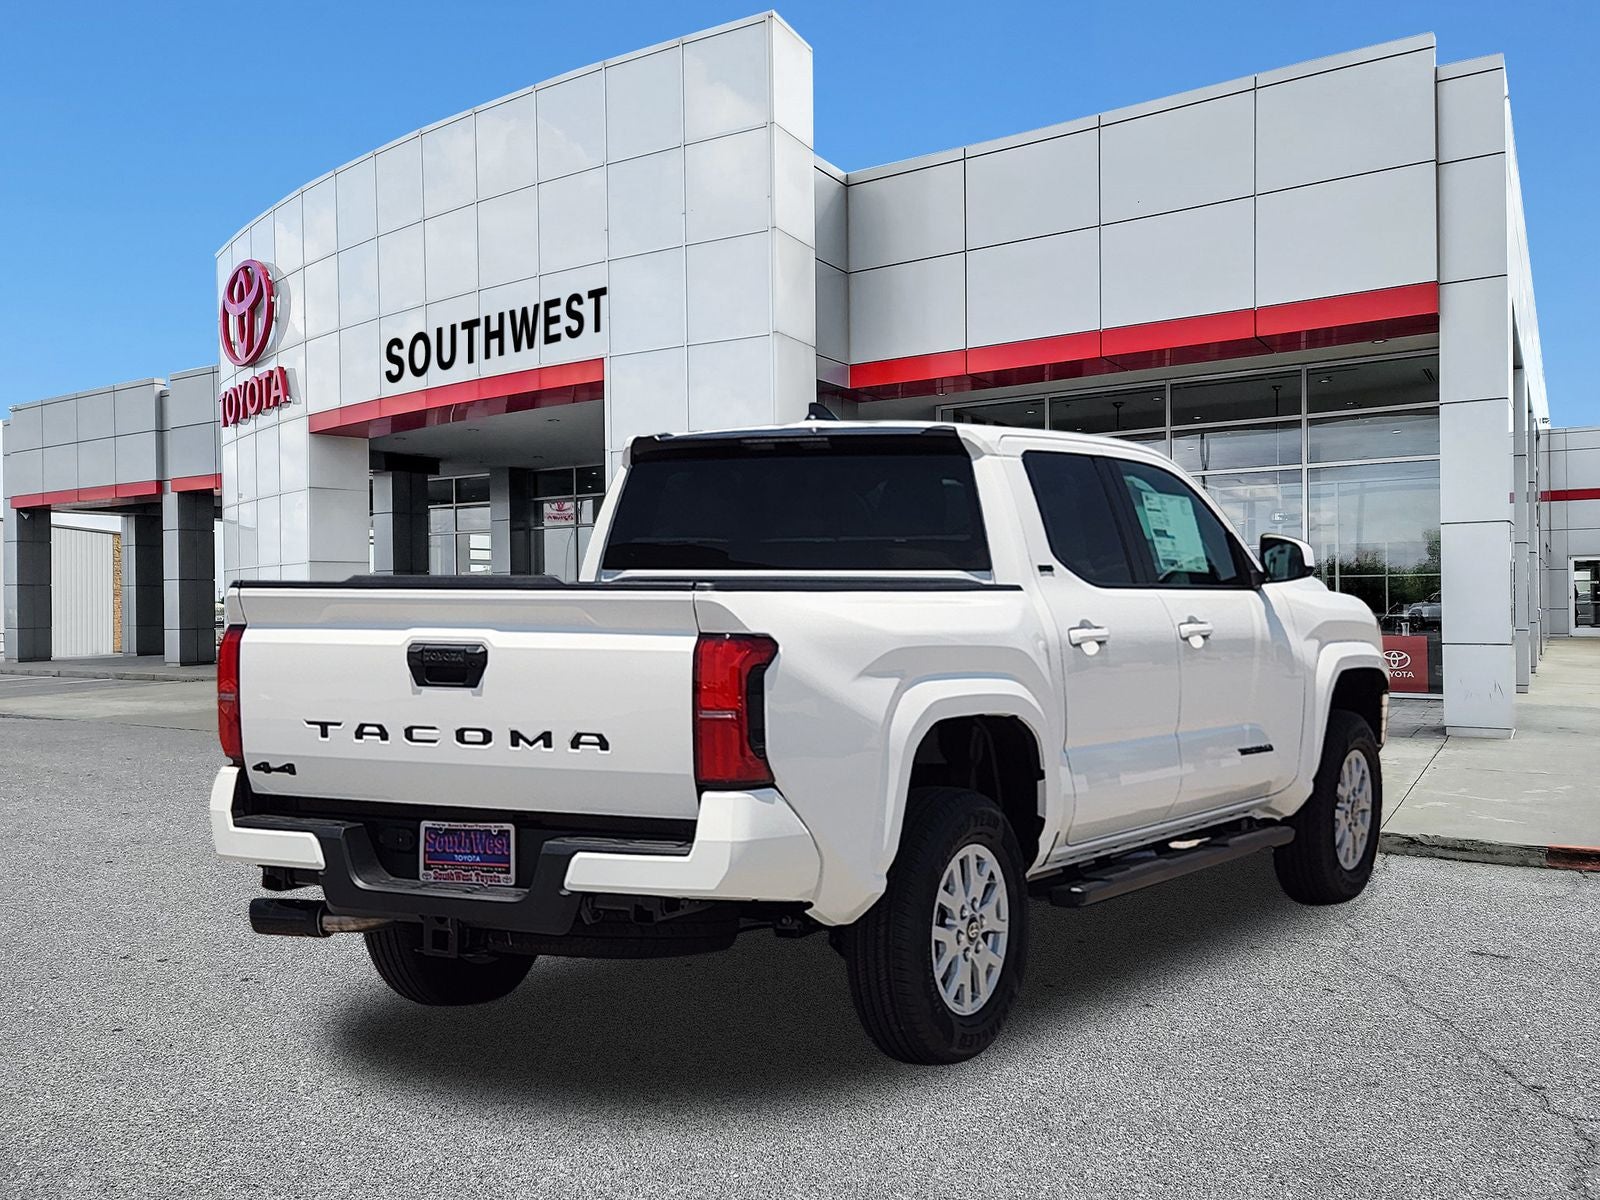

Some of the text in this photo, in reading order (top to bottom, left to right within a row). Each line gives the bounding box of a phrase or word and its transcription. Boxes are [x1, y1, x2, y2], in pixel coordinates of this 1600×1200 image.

[385, 287, 607, 384] SOUTHWEST
[219, 366, 291, 428] TOYOTA
[304, 720, 610, 752] TACOMA
[252, 761, 297, 776] 44
